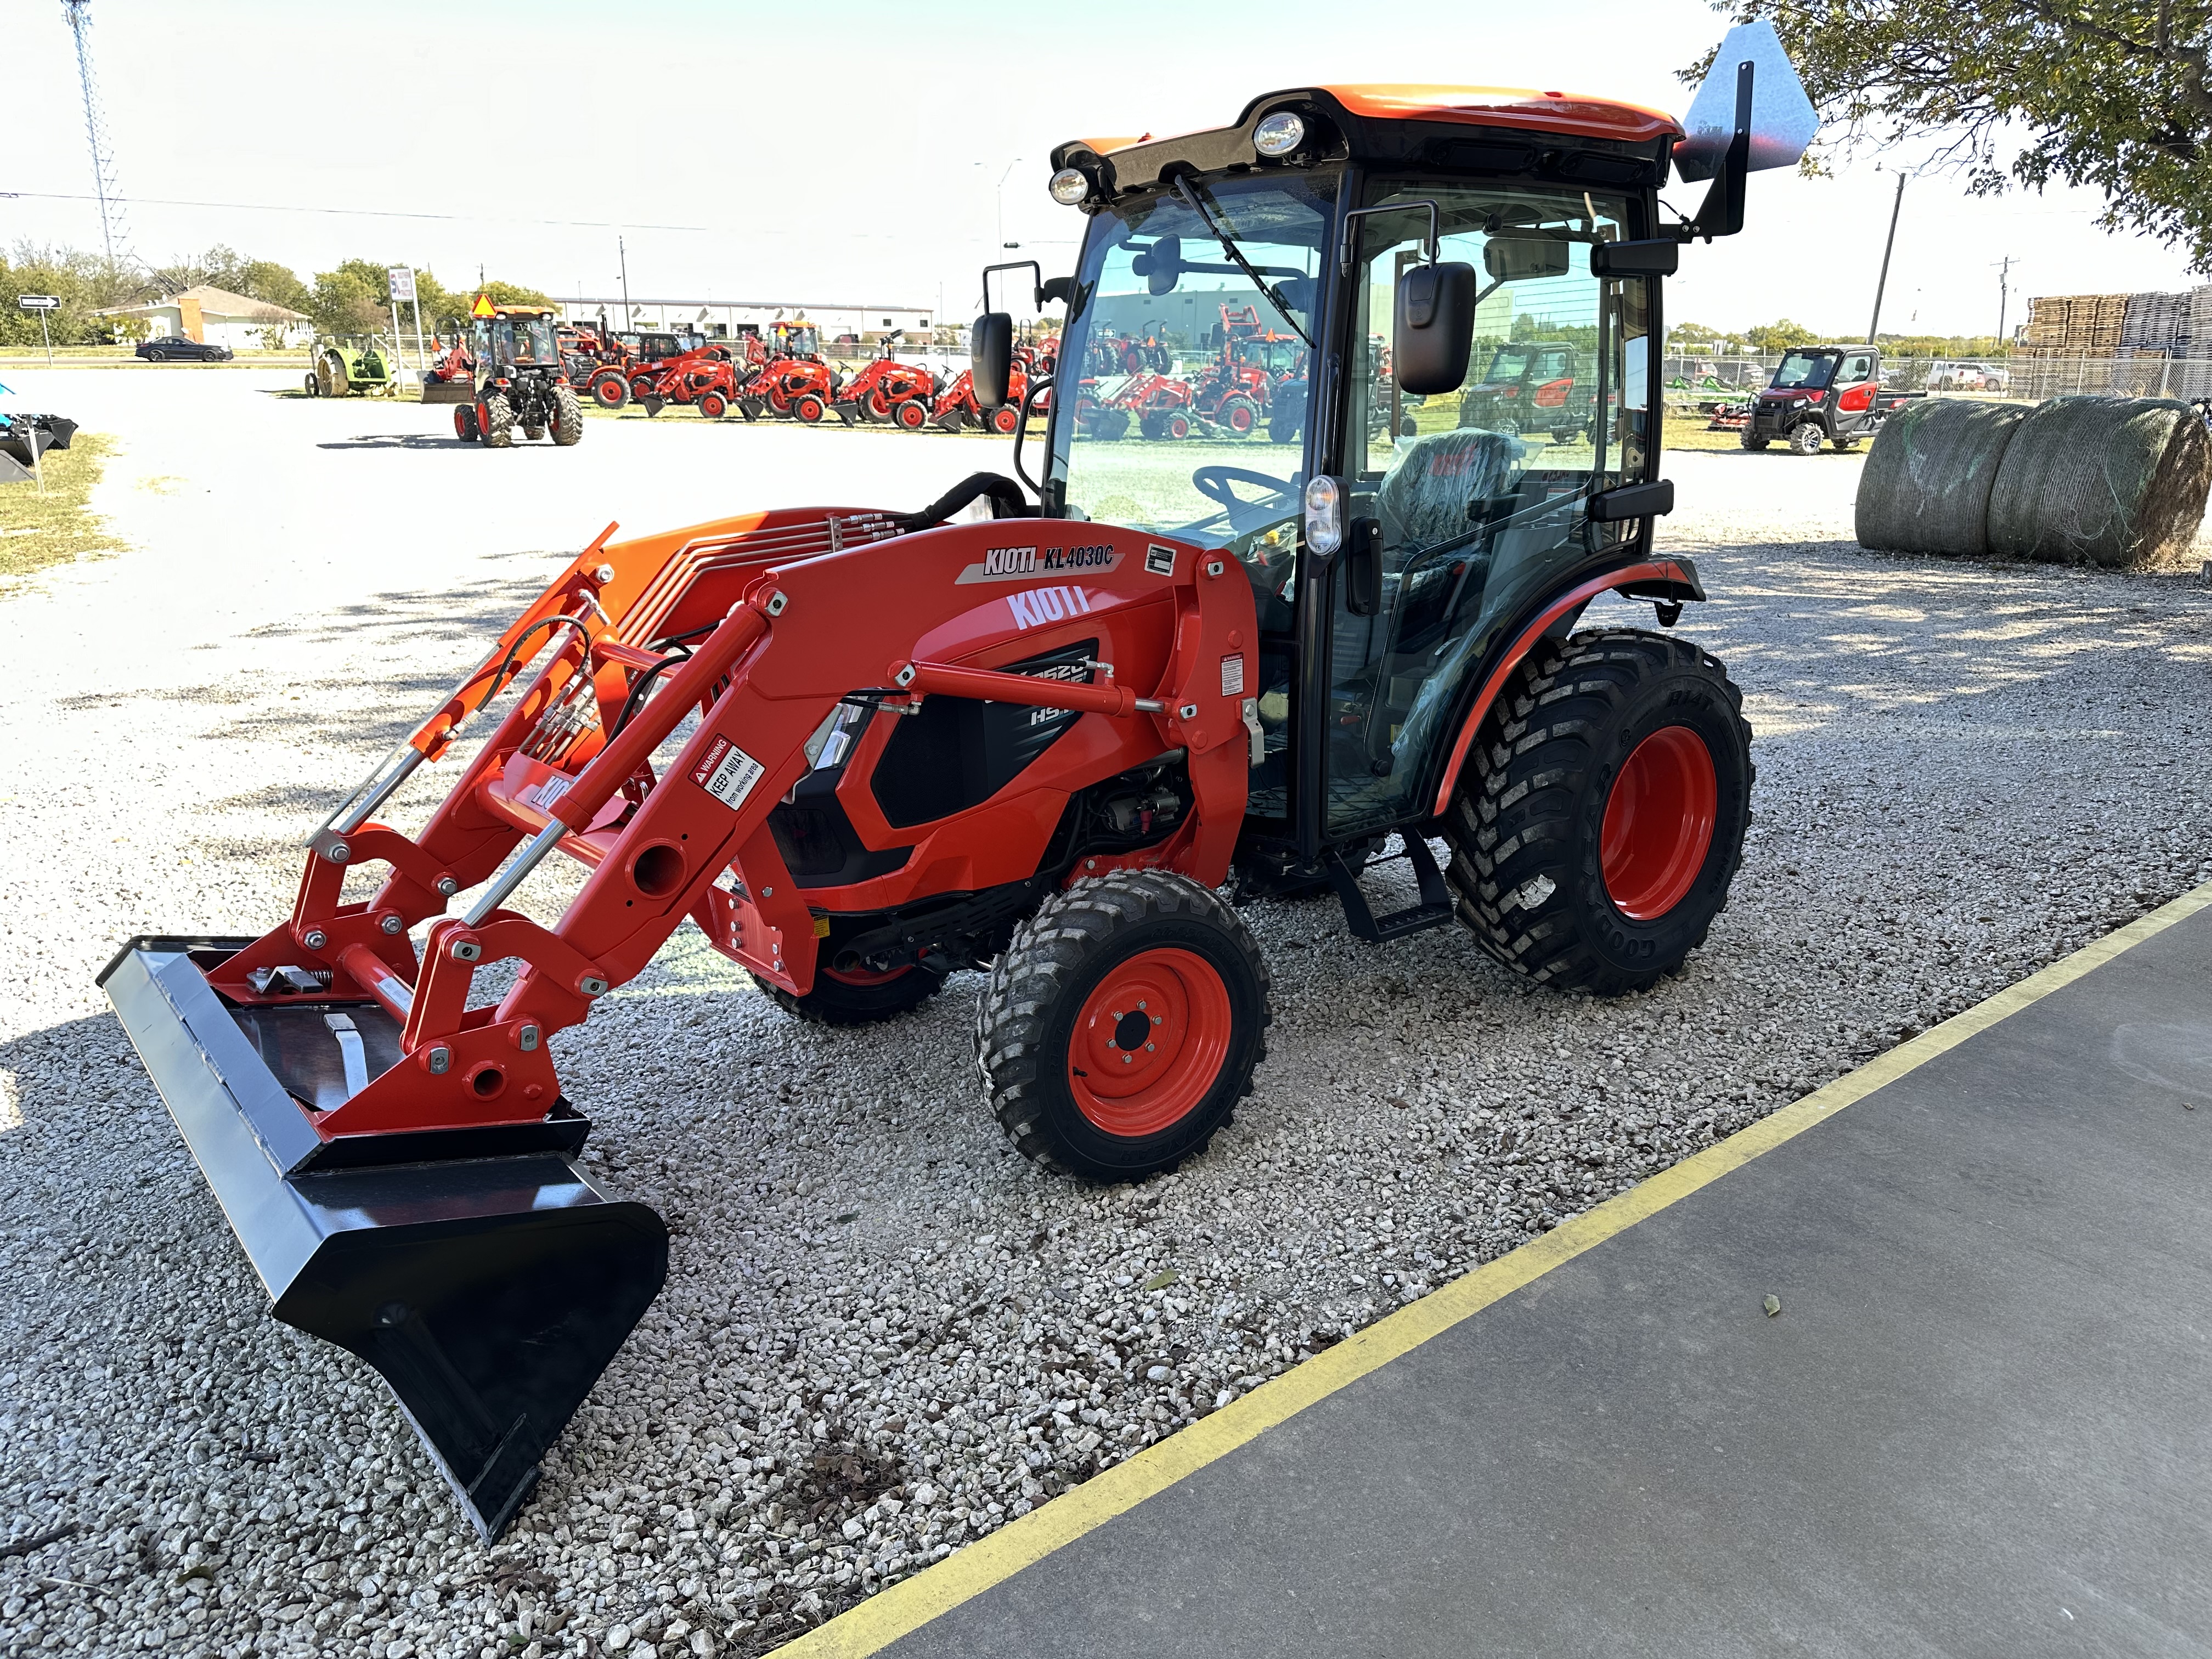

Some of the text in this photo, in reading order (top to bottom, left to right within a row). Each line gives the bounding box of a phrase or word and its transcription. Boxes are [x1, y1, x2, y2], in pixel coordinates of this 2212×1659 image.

[984, 544, 1114, 575] KIOTI KL4030C
[1006, 586, 1090, 630] KIOTI
[700, 739, 727, 772] WARNING
[710, 751, 746, 797] KEEP AWAY
[531, 774, 570, 810] KIO
[725, 763, 759, 805] from working area
[1582, 762, 1656, 960] GOODYEAR
[1120, 1081, 1235, 1163] GOODYEAR
